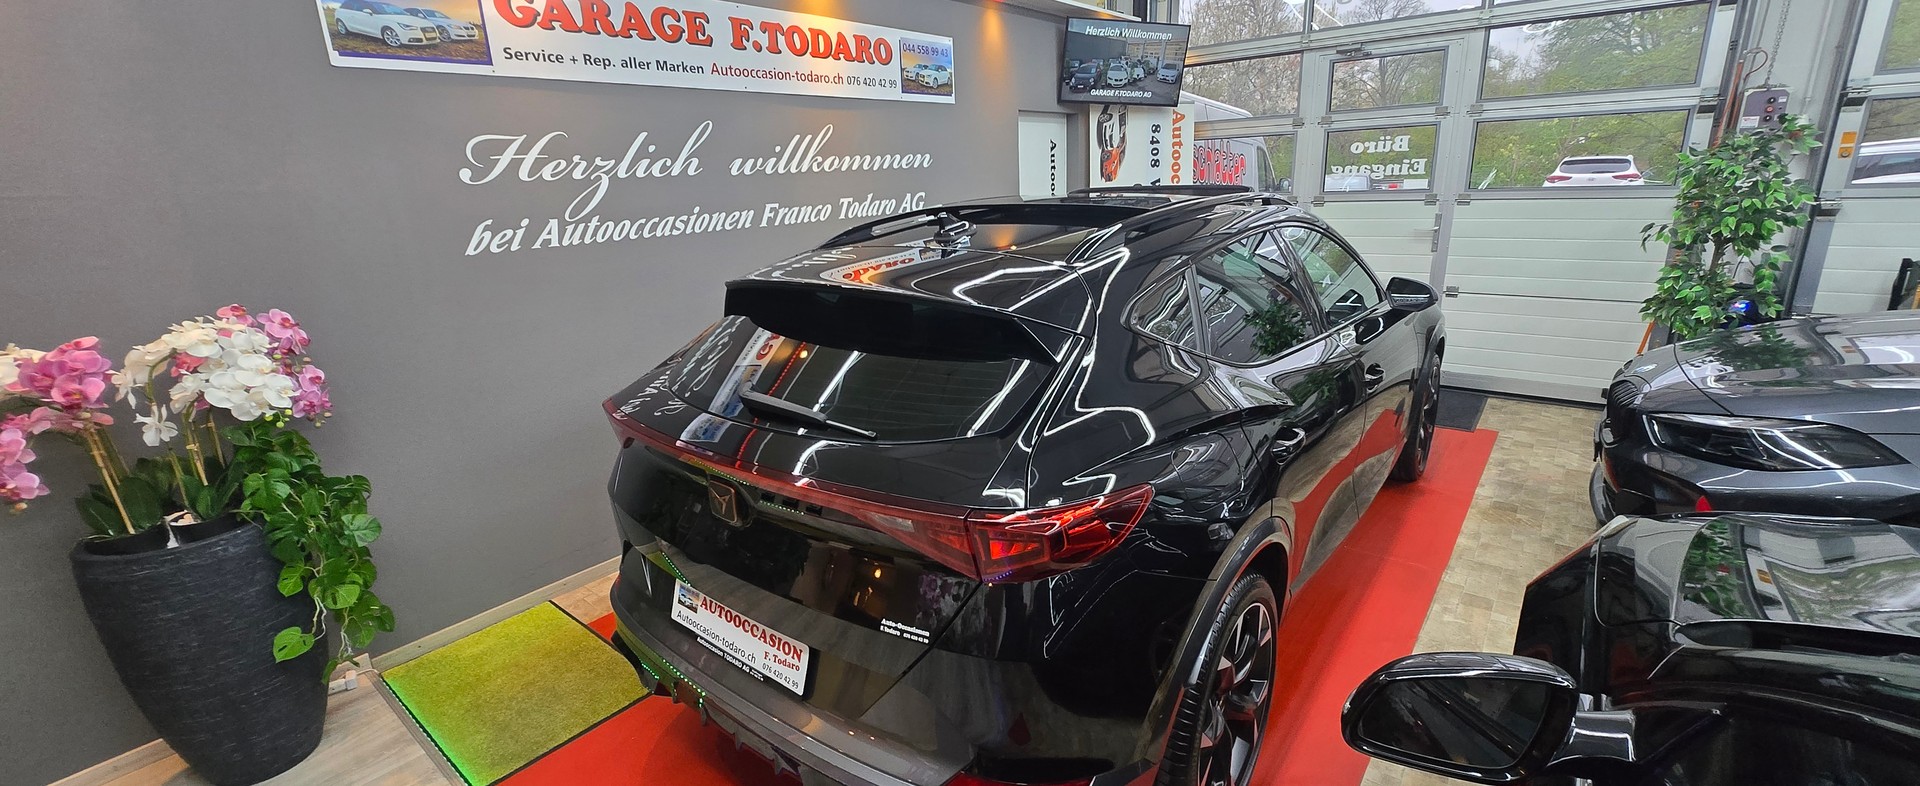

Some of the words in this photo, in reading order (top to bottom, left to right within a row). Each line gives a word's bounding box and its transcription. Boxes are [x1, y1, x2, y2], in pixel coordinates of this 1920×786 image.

[494, 0, 713, 48] GARAGE
[728, 16, 894, 67] F.TODARO
[902, 42, 915, 53] 044
[917, 45, 930, 55] 558
[931, 47, 939, 56] 99
[940, 49, 949, 57] 43
[1085, 25, 1120, 37] Herzlich
[1121, 28, 1172, 40] Willkommen
[503, 47, 564, 64] Service
[570, 56, 579, 65] +
[583, 53, 616, 69] Rep.
[621, 56, 651, 70] aller
[656, 60, 704, 75] Marken
[711, 62, 844, 86] Autooccasion-todaro.ch
[846, 75, 861, 87] 076
[863, 76, 877, 87] 420
[878, 77, 888, 88] 42
[889, 79, 898, 89] 99
[1090, 88, 1115, 97] GARAGE
[1143, 90, 1152, 98] AG
[1150, 124, 1161, 168] 8408
[458, 120, 713, 222] Herzlich
[728, 123, 933, 176] willkommen
[465, 218, 530, 256] bei
[531, 205, 755, 249] Autooccasionen
[759, 203, 832, 229] Franco
[838, 192, 897, 220] Todaro
[898, 191, 926, 214] AG
[676, 610, 757, 664] Autooccasion-todaro.ch
[699, 595, 803, 664] AUTOOCCASION
[762, 663, 773, 673] 076
[773, 669, 784, 680] 420
[783, 675, 792, 685] 42
[791, 680, 799, 689] 99
[763, 651, 771, 661] F.
[773, 654, 801, 672] Todaro
